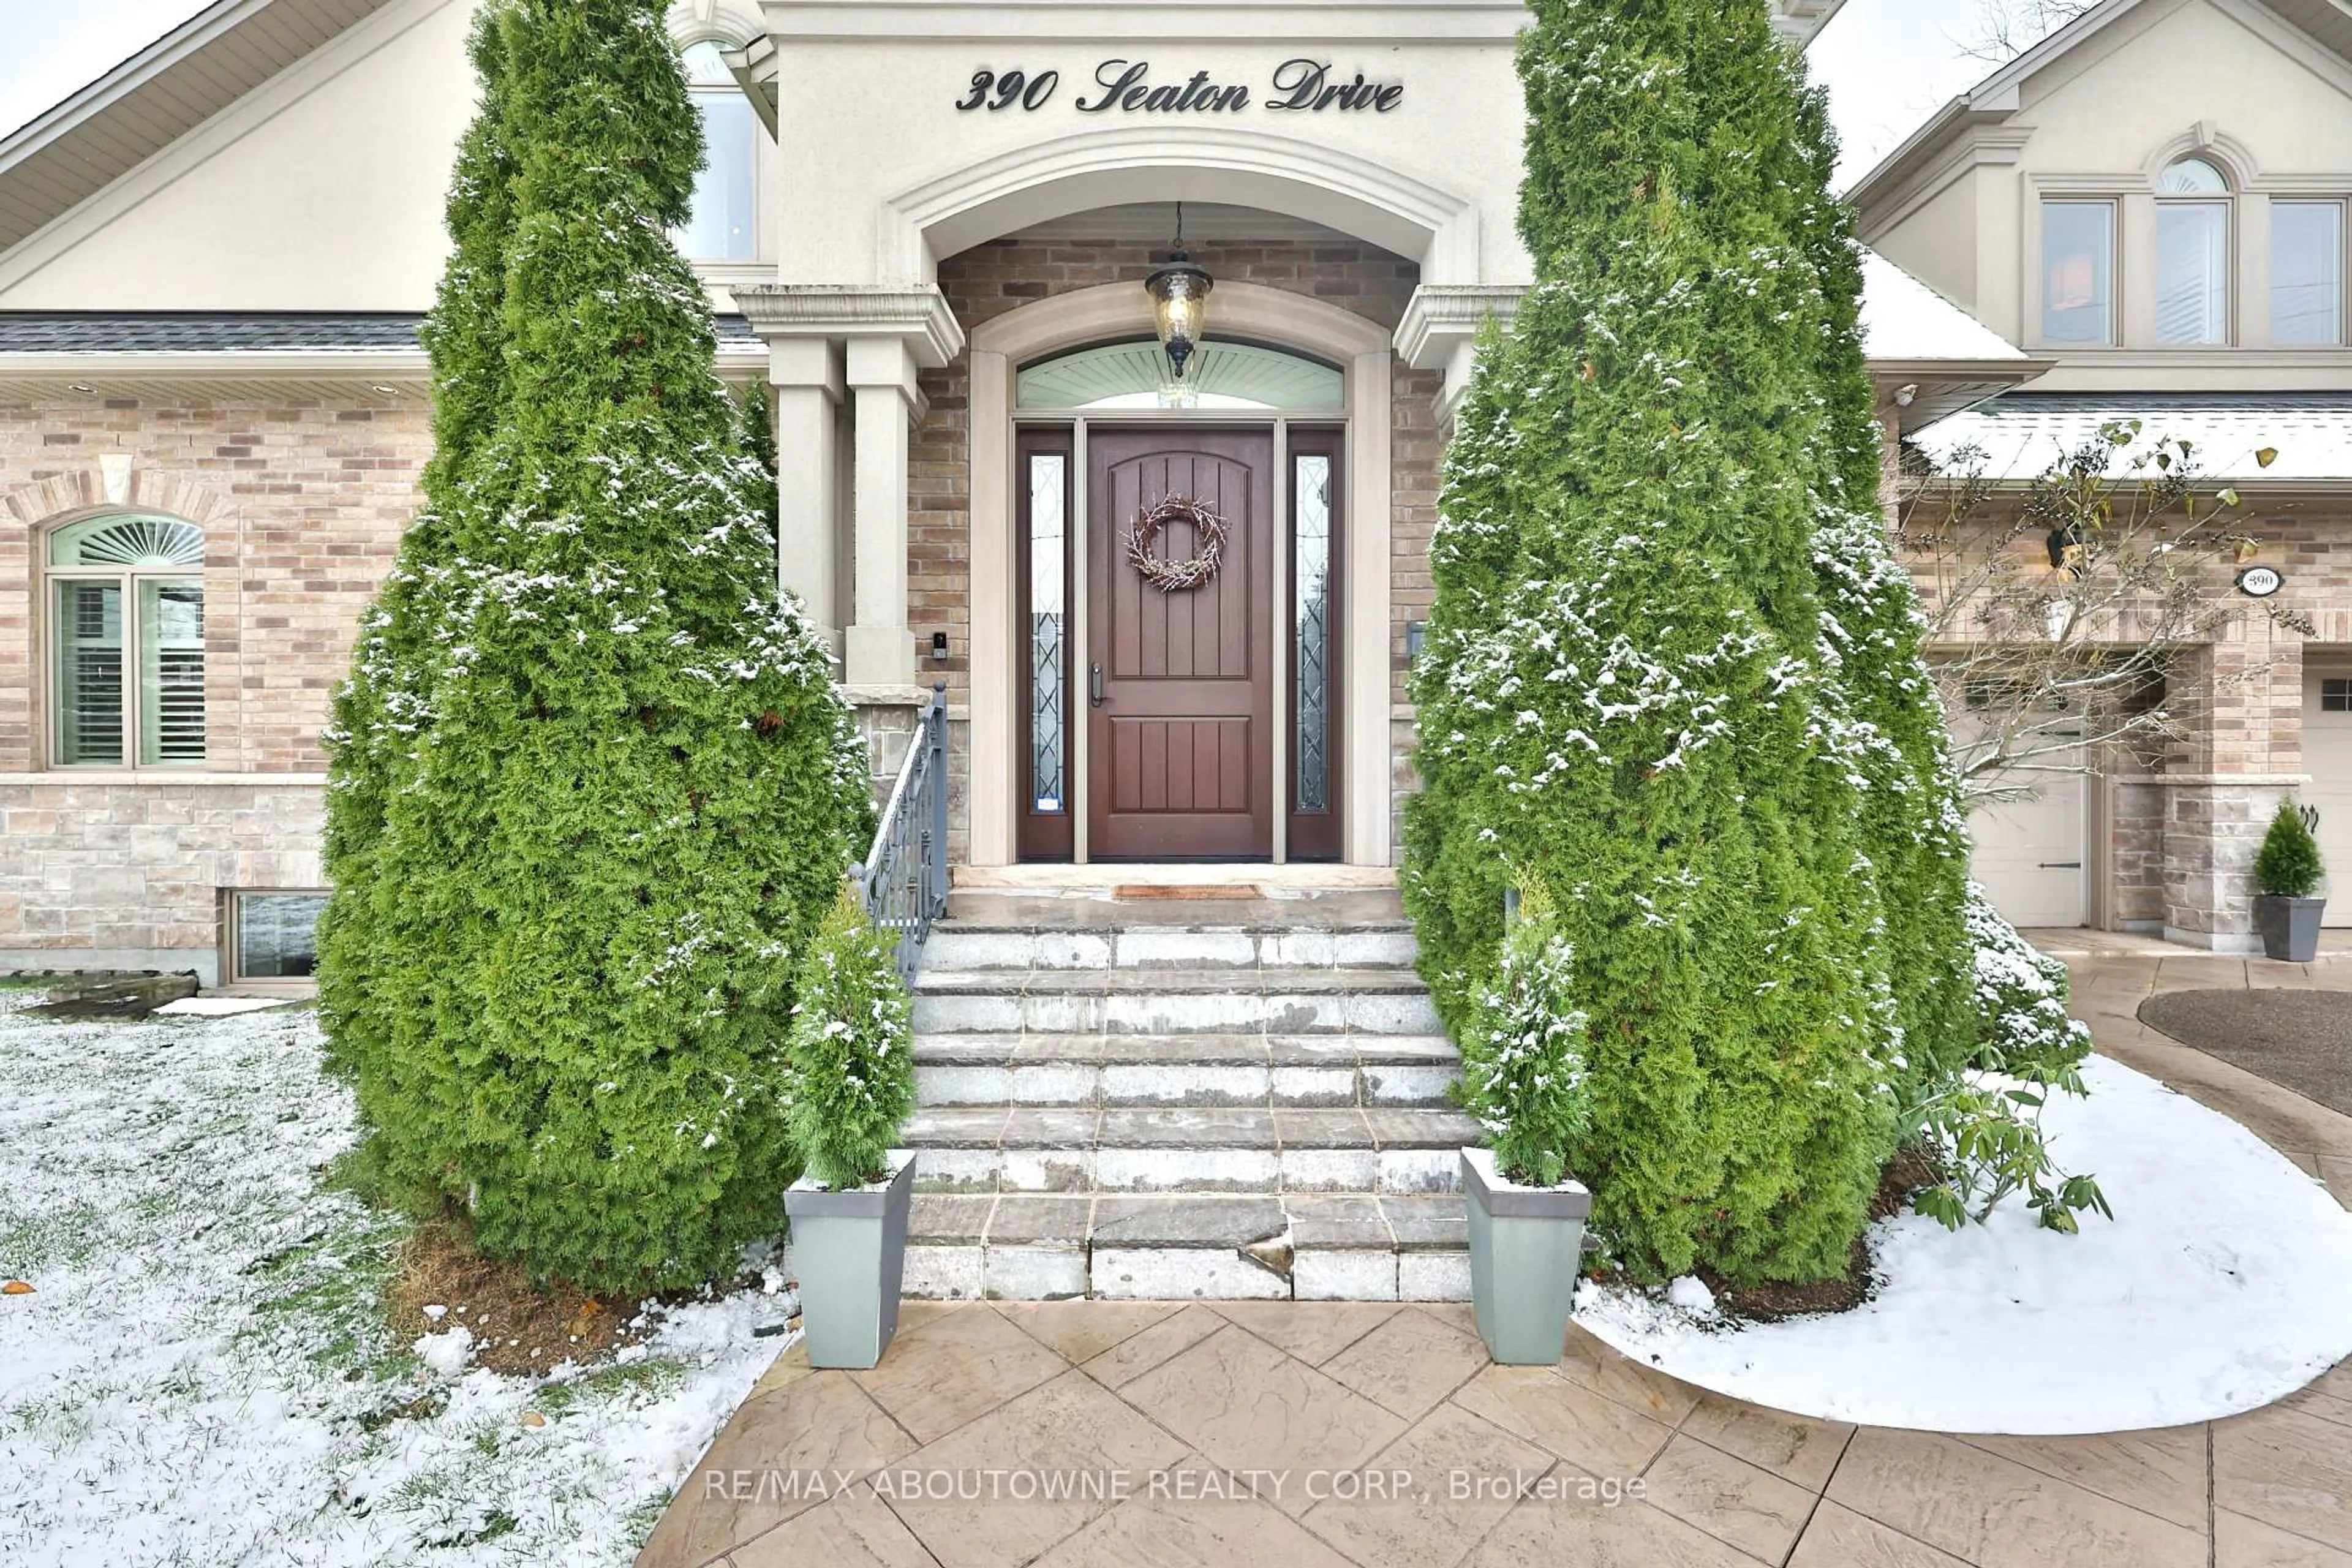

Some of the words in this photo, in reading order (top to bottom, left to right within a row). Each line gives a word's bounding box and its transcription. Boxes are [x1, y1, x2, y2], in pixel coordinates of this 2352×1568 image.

[956, 70, 1059, 111] 390
[1076, 59, 1250, 112] Seaton
[1265, 59, 1404, 113] Drive
[2248, 575, 2273, 586] 390
